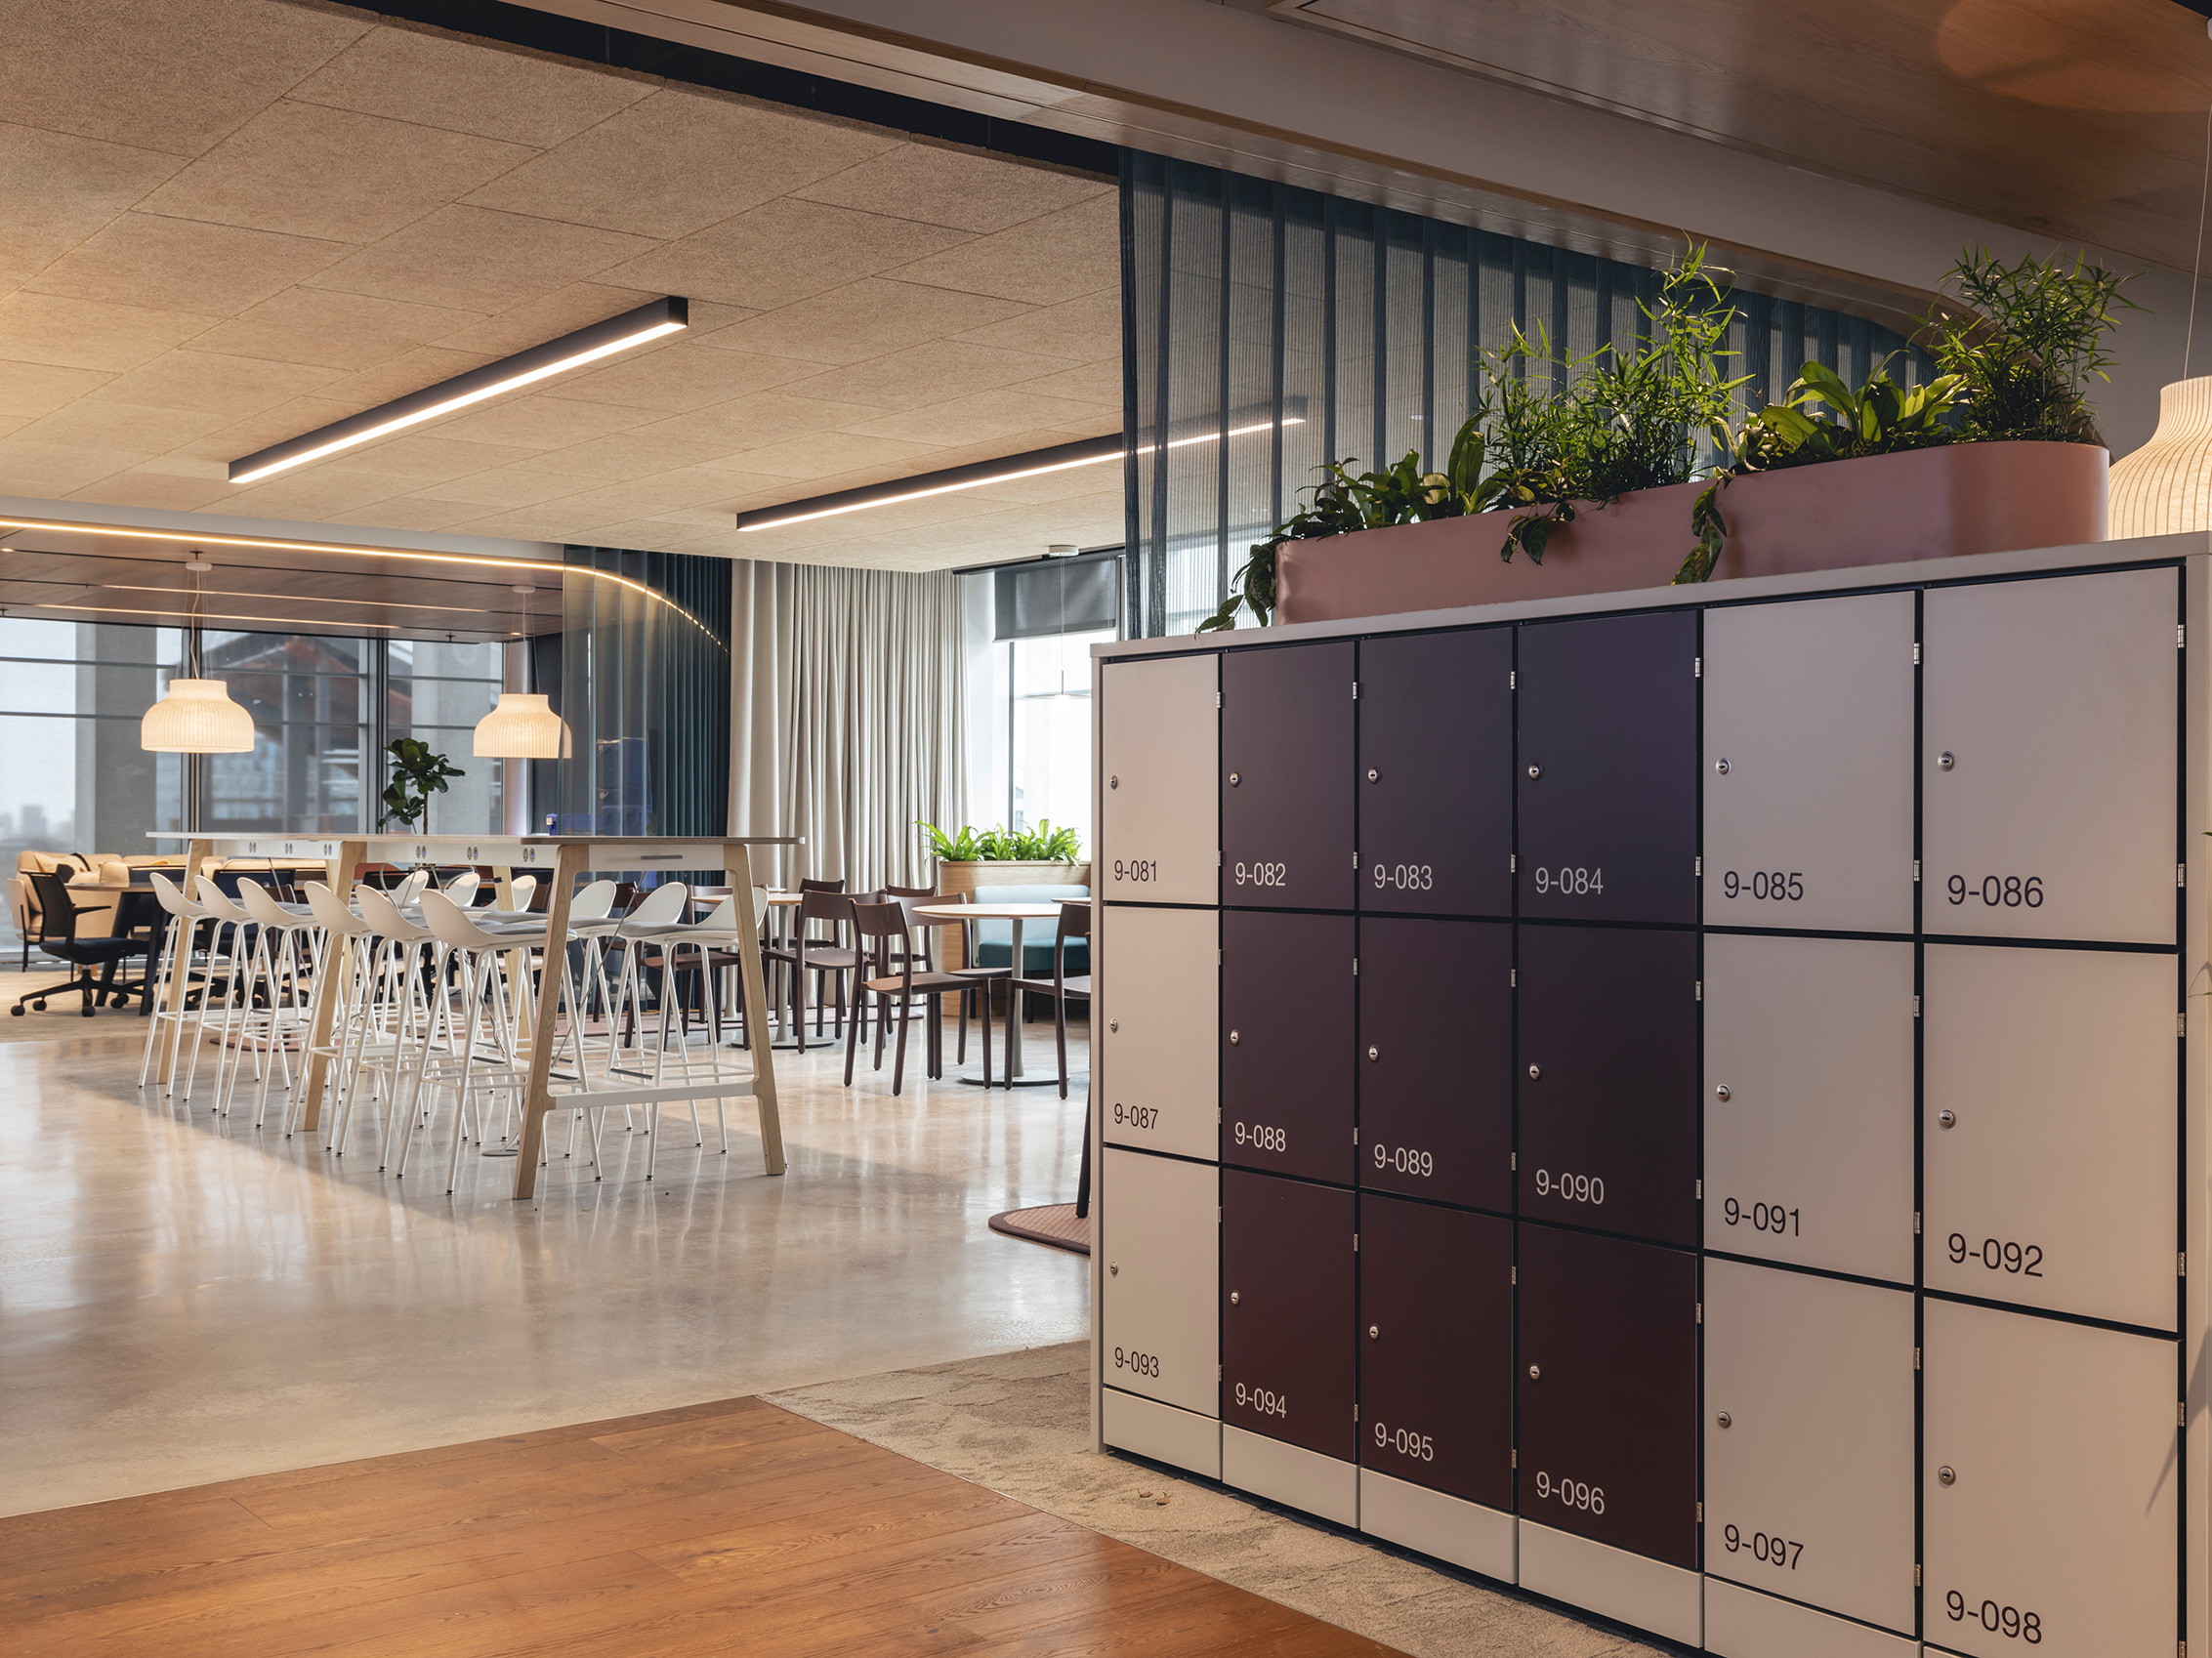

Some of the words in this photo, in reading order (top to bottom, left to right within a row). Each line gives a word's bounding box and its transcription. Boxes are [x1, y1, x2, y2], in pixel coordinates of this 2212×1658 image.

[1114, 860, 1155, 882] 9-081
[1235, 862, 1285, 886] 9-082
[1374, 864, 1432, 890] 9-083
[1536, 867, 1603, 894] 9-084
[1725, 871, 1803, 900] 9-085
[1948, 875, 2043, 908] 9-086
[1114, 1103, 1158, 1129] 9-087
[1235, 1122, 1285, 1151] 9-088
[1375, 1144, 1433, 1177] 9-089
[1536, 1169, 1604, 1204] 9-090
[1725, 1198, 1799, 1236] 9-091
[1948, 1233, 2042, 1277] 9-092
[1115, 1347, 1159, 1378] 9-093
[1236, 1383, 1286, 1418] 9-094
[1375, 1423, 1433, 1461] 9-095
[1537, 1471, 1605, 1514] 9-096
[1725, 1524, 1804, 1570] 9-097
[1946, 1591, 2042, 1644] 9-098
